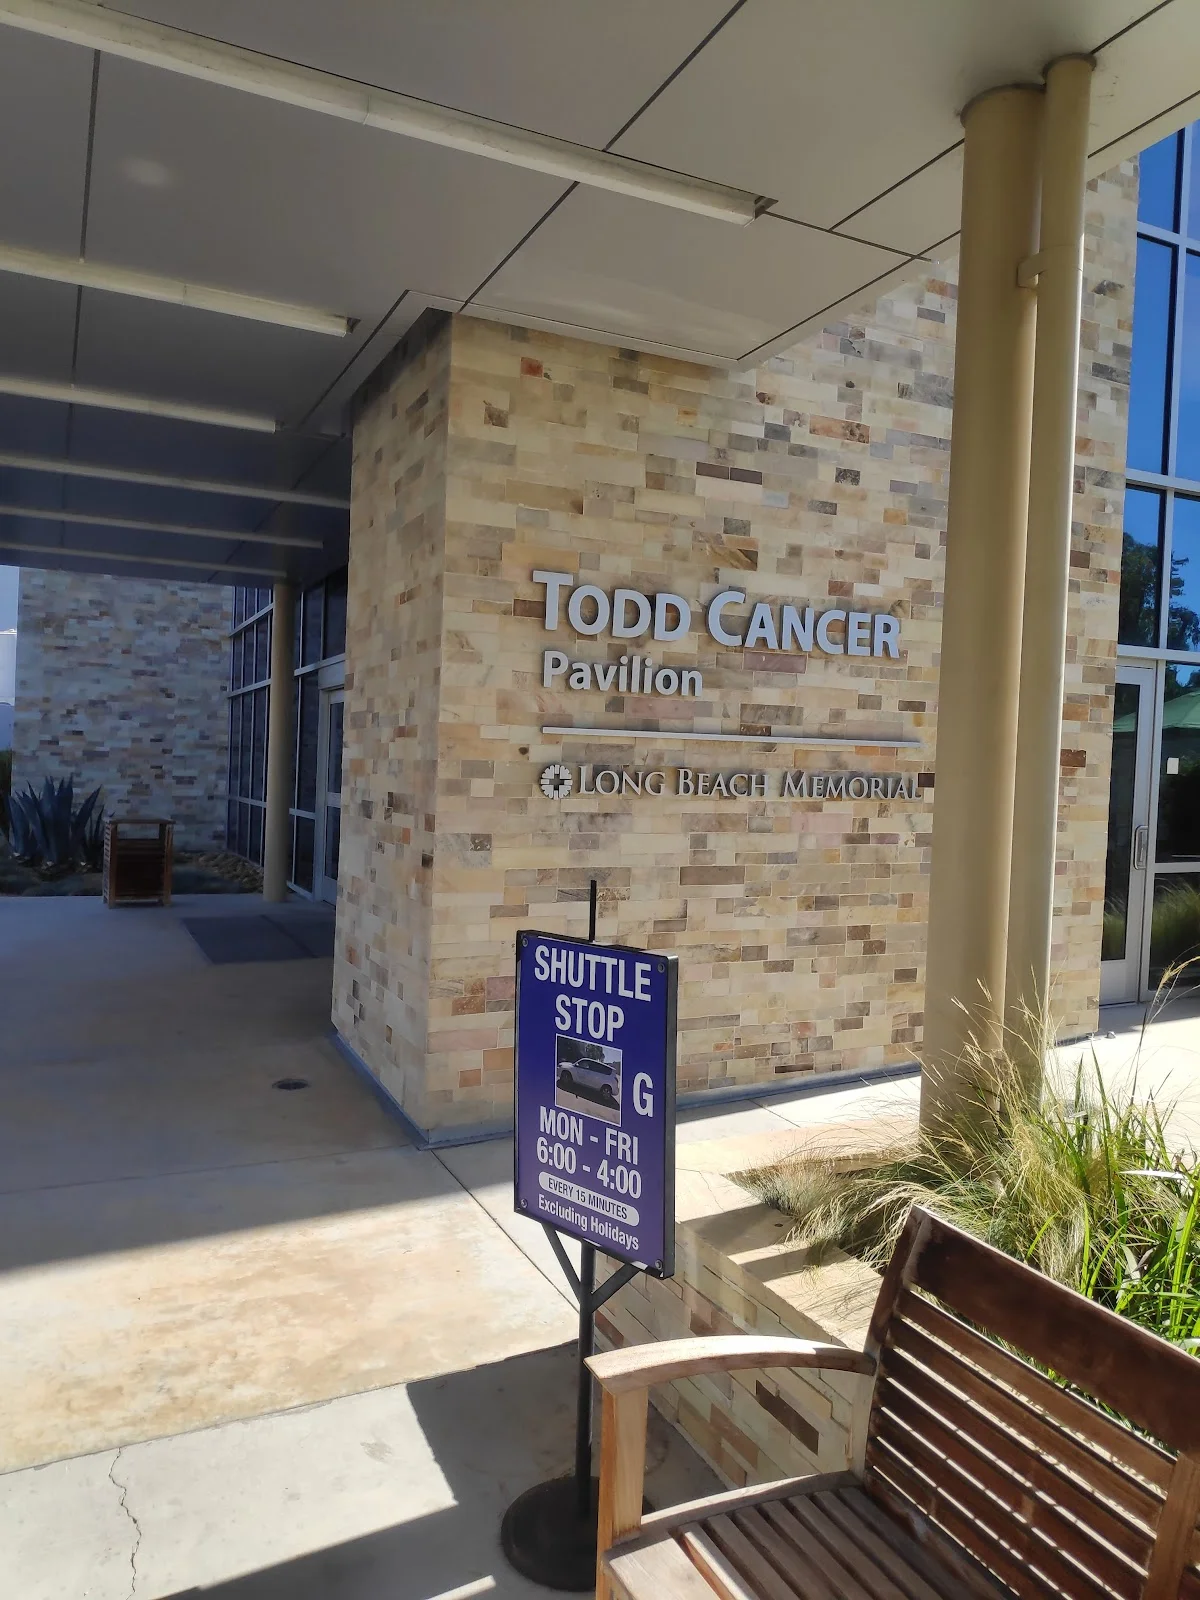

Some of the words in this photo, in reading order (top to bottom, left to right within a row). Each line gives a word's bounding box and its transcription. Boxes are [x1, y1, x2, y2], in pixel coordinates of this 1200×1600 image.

[532, 570, 692, 642] TODD
[707, 590, 901, 658] CANCER
[543, 650, 703, 697] Pavilion
[578, 765, 666, 798] LONG
[676, 768, 770, 799] BEACH
[781, 771, 922, 801] MEMORIAL
[534, 944, 652, 1002] SHUTTLE
[554, 993, 625, 1043] STOP
[632, 1072, 654, 1118] G
[539, 1105, 584, 1147] MON
[605, 1127, 639, 1166] FRI
[536, 1136, 577, 1175] 6:00
[596, 1159, 642, 1199] 4:00
[538, 1193, 588, 1233] Excluding
[590, 1213, 639, 1251] Holidays
[548, 1177, 575, 1198] EVERY
[576, 1189, 587, 1203] 15
[588, 1194, 628, 1220] MINUTES
